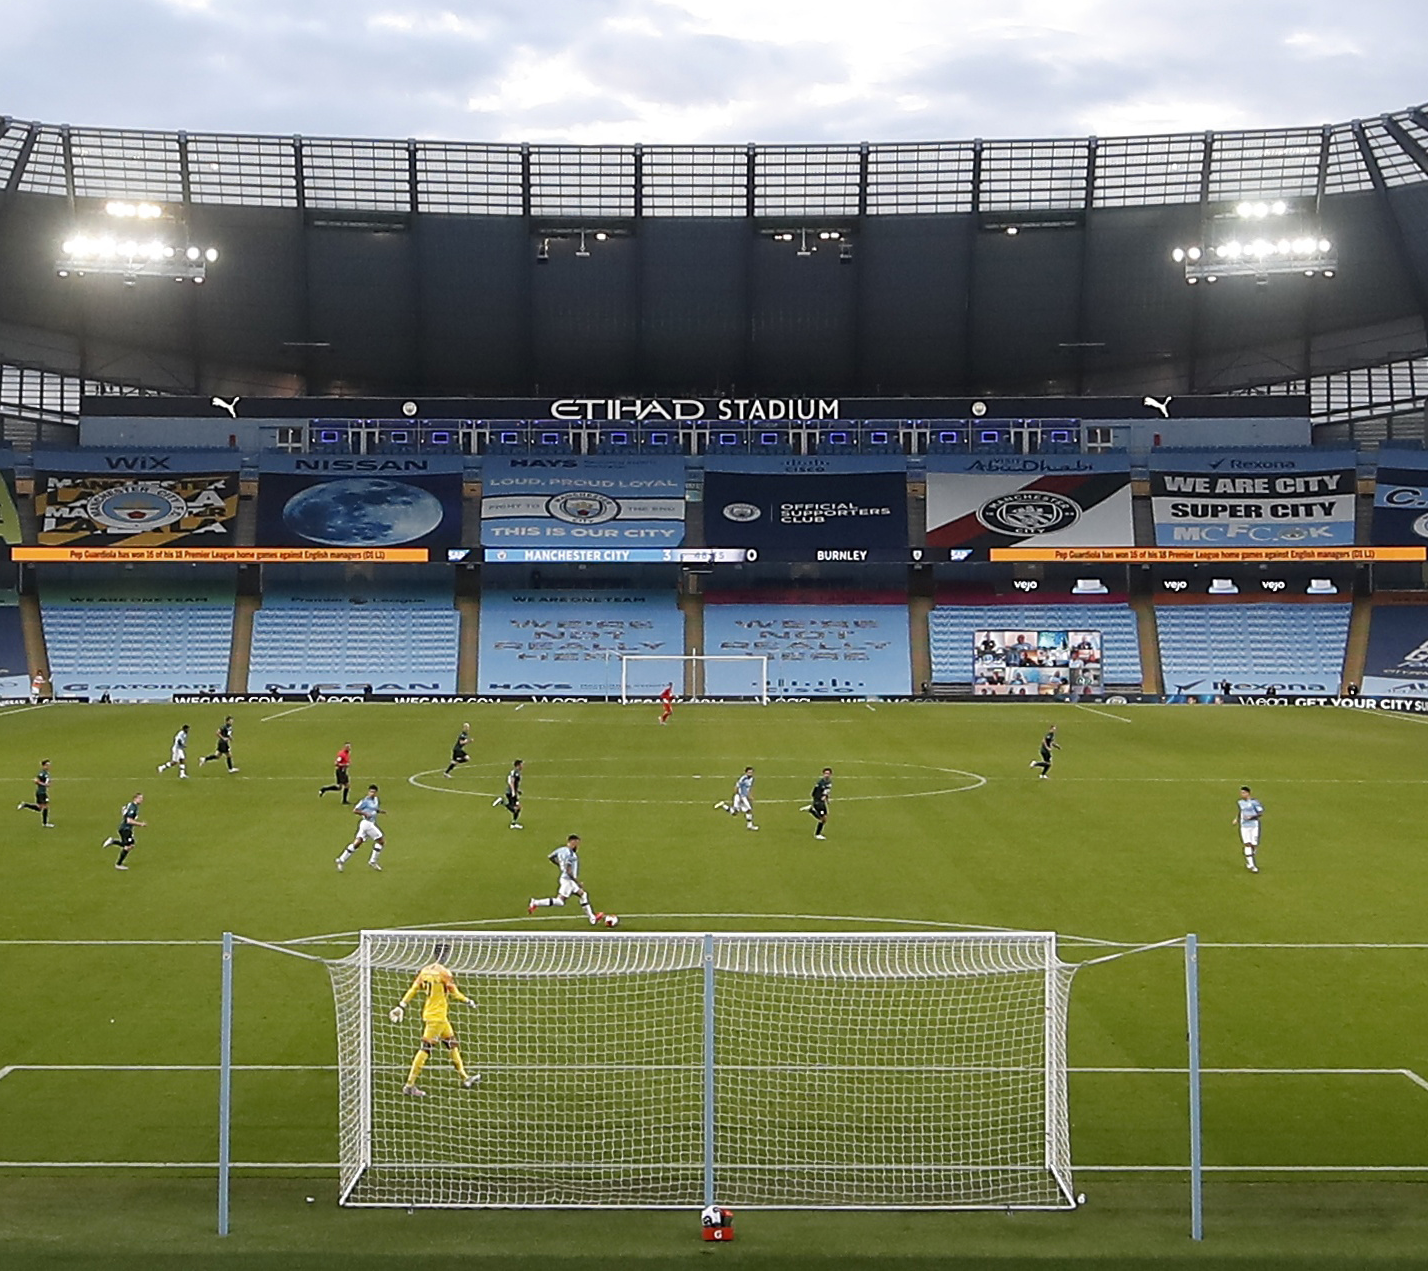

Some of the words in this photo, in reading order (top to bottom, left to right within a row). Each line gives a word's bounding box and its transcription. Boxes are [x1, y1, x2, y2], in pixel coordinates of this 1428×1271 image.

[550, 399, 705, 420] ETIHAD
[717, 399, 839, 420] STADIUM
[295, 459, 428, 471] NISSAN
[510, 459, 578, 468] HAYS
[964, 460, 1016, 472] Abu
[1021, 460, 1093, 472] Dhabi
[1230, 459, 1296, 469] Rexona
[550, 479, 614, 487] PROUD
[1164, 476, 1210, 493] WE
[1215, 477, 1270, 494] ARE
[1275, 474, 1342, 494] CITY
[988, 494, 1070, 509] MANCHESTER
[781, 507, 891, 517] SUPPORTERS
[1171, 502, 1263, 518] SUPER
[1270, 501, 1337, 518] CITY
[781, 516, 826, 524] CLUB
[490, 527, 541, 537] THIS
[545, 528, 566, 536] IS
[570, 528, 619, 537] OUR
[623, 529, 676, 538] CITY
[70, 550, 82, 559] Pep
[84, 550, 117, 558] Guardiola
[118, 550, 130, 558] has
[155, 550, 163, 558] of
[164, 550, 173, 558] his
[184, 550, 210, 558] Premier
[212, 550, 235, 559] League
[236, 550, 254, 558] home
[279, 550, 303, 559] against
[304, 550, 328, 559] English
[330, 550, 361, 559] managers
[524, 550, 605, 561] MANCHESTER
[606, 550, 630, 561] CITY
[662, 550, 671, 561] 3
[746, 549, 758, 561] 0
[817, 550, 868, 561] BURNLEY
[1014, 581, 1037, 591] vejo
[1164, 581, 1187, 591] vejo
[1262, 581, 1285, 591] vejo
[94, 683, 221, 691] GATORADE
[265, 683, 440, 691] NISSAN
[1295, 697, 1328, 707] GET
[1332, 698, 1377, 710] YOUR
[1380, 699, 1413, 711] CITY
